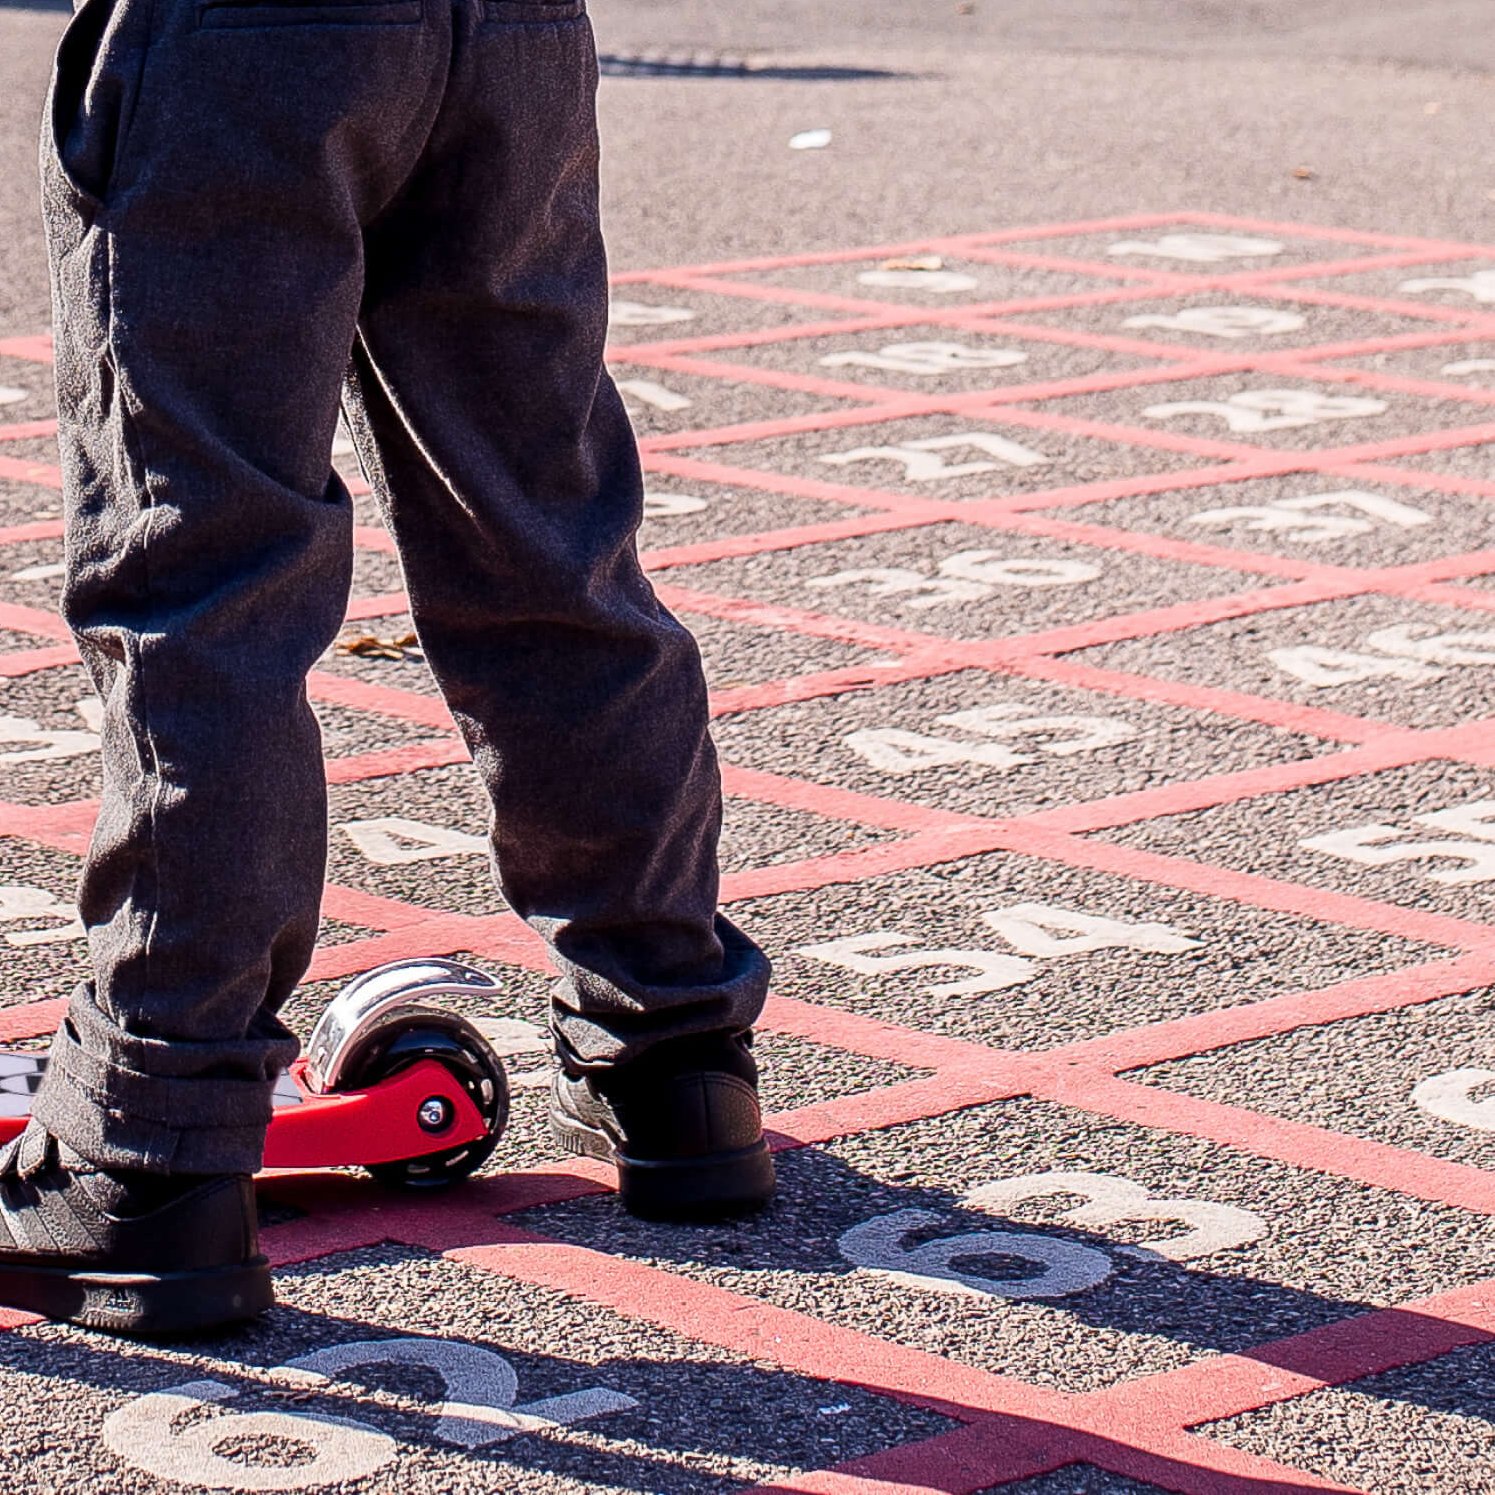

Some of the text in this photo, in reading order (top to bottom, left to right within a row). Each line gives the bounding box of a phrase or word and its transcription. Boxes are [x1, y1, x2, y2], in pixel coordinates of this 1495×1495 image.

[818, 431, 1051, 481] 27
[1186, 489, 1433, 543] 37
[844, 709, 1138, 774] 45
[797, 904, 1210, 999] 54
[838, 1170, 1269, 1300] 63
[105, 1337, 640, 1491] 62
